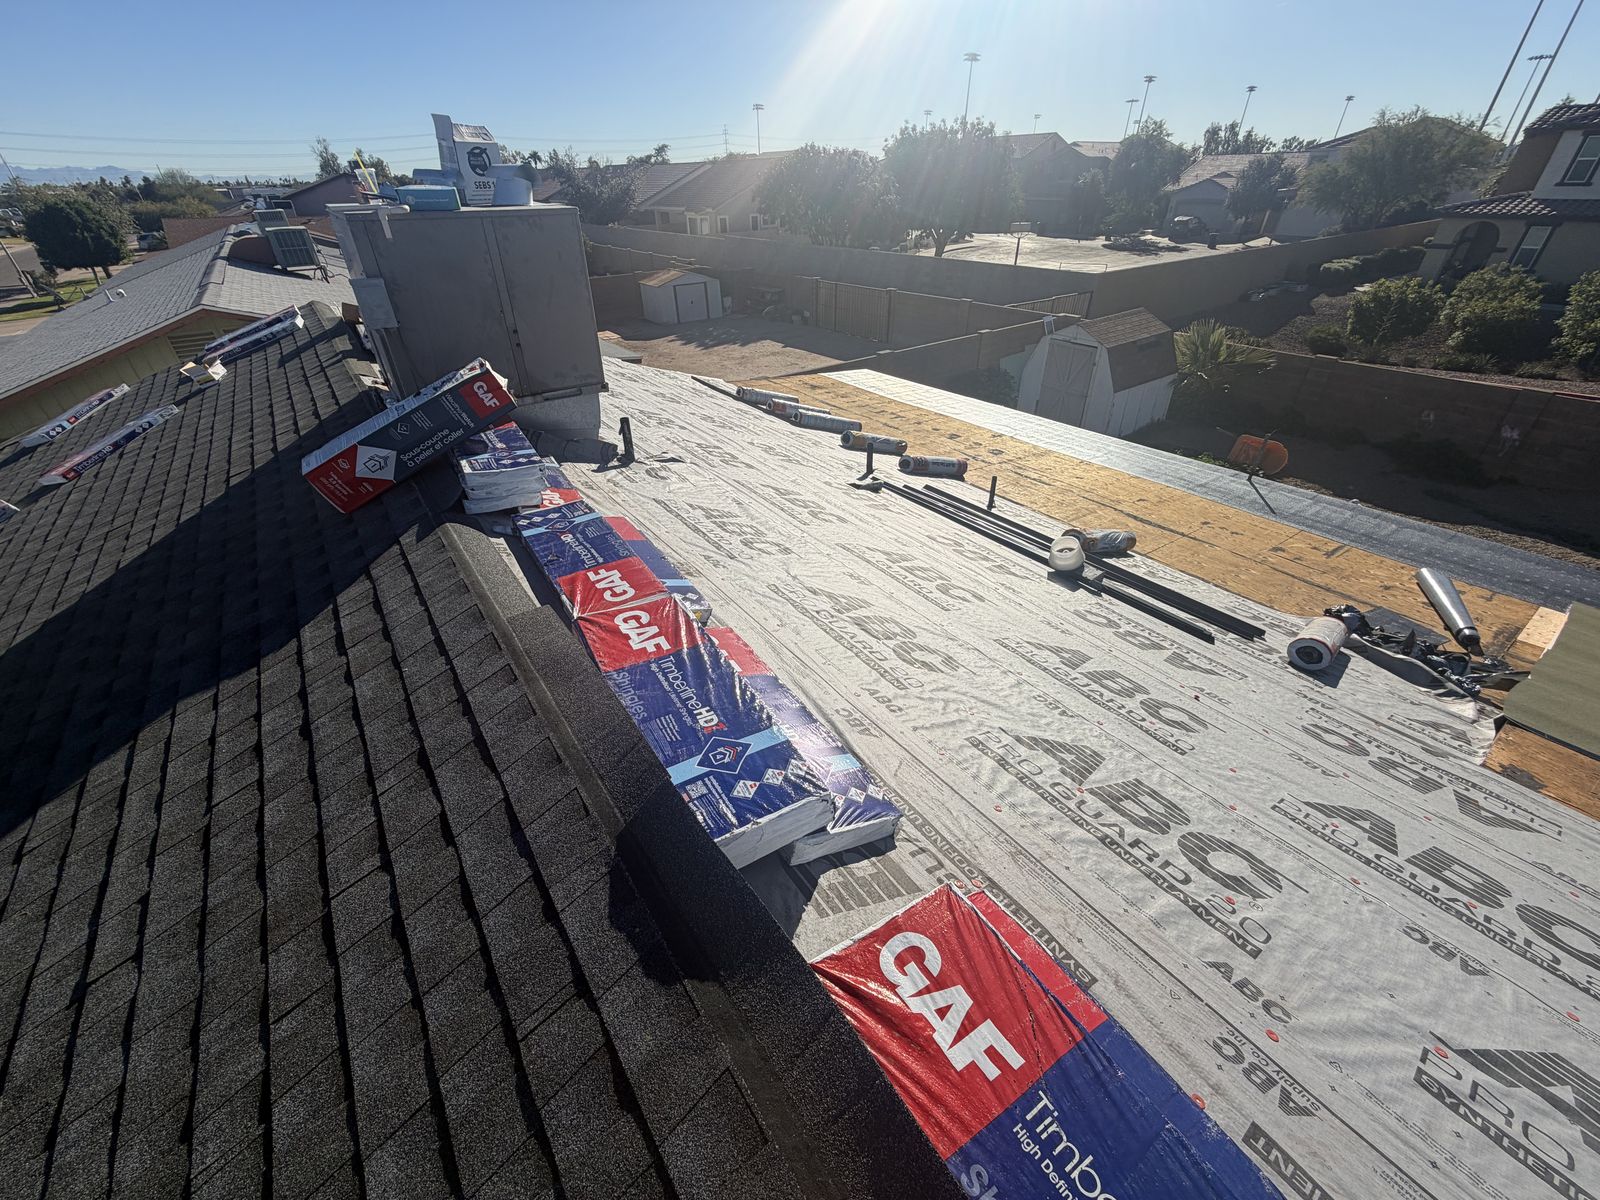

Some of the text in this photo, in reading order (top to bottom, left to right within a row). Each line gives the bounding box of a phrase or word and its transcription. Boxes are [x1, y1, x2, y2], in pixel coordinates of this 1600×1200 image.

[473, 381, 500, 408] GAF
[400, 428, 440, 461] Sous-couche
[415, 447, 435, 465] peler
[434, 441, 444, 449] et
[444, 428, 465, 444] coller
[587, 569, 636, 602] GAF
[614, 610, 671, 653] GAF
[814, 609, 889, 662] GUARD
[613, 671, 648, 720] Shingles
[1016, 636, 1228, 735] ABC
[1052, 666, 1148, 724] GUARD
[977, 730, 1043, 776] PRO
[1049, 782, 1193, 886] GUARD
[998, 726, 1310, 900] ABC
[1037, 788, 1103, 840] ROOFING
[1104, 837, 1260, 956] UNDERLAYMENT
[1276, 797, 1359, 848] PRO
[1373, 852, 1562, 966] GUARD
[1368, 860, 1457, 916] ROOFING
[1396, 924, 1497, 981] ABC
[879, 931, 1025, 1082] GAF
[1198, 956, 1301, 1025] ABC
[1203, 1032, 1324, 1122] ABC
[1249, 1047, 1271, 1068] Co.
[1271, 1068, 1322, 1113] Supply
[1418, 1045, 1577, 1173] PRO
[1013, 1123, 1042, 1160] High
[1025, 1090, 1120, 1200] Timb
